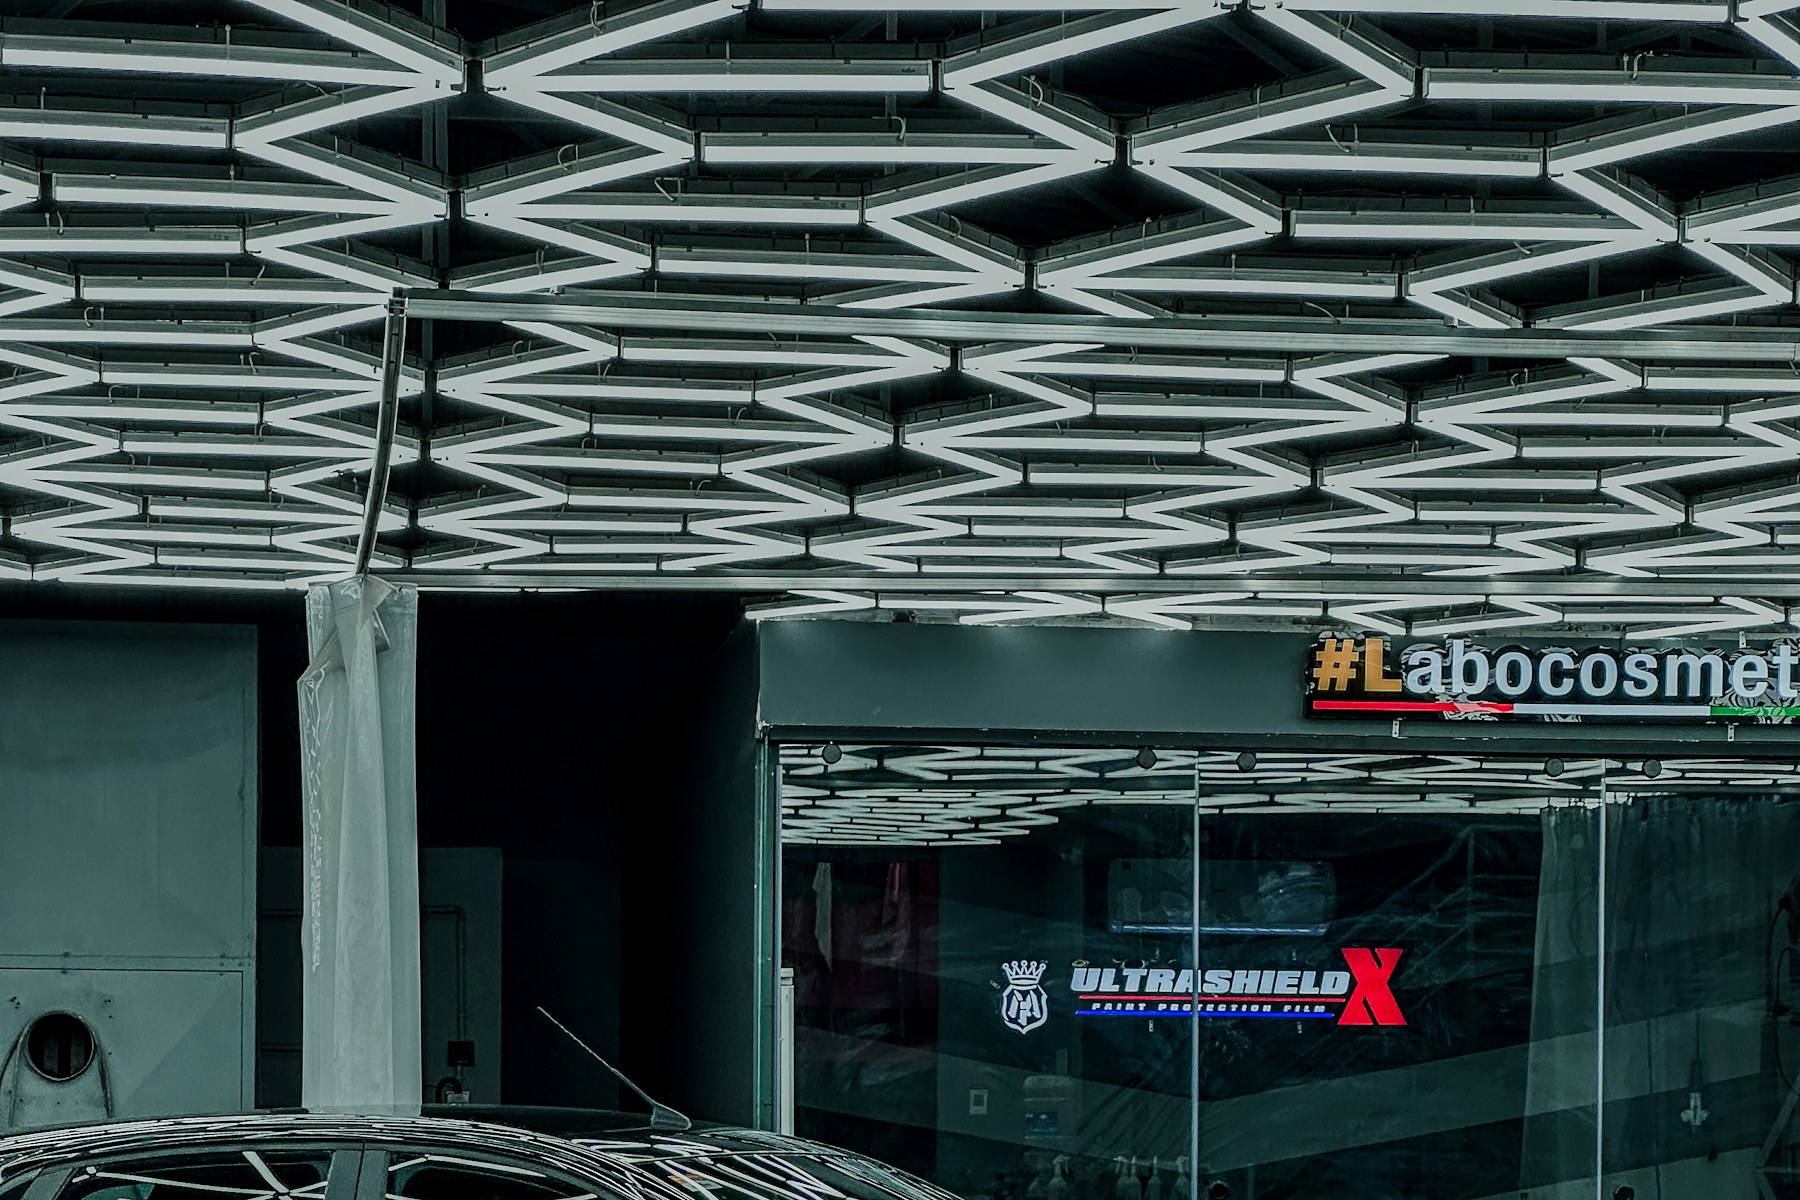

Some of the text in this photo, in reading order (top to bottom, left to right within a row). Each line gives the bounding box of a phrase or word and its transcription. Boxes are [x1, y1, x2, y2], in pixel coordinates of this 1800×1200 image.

[1312, 638, 1799, 697] #Labocosmet
[1091, 1002, 1326, 1013] PAINT PROTECTION FILM
